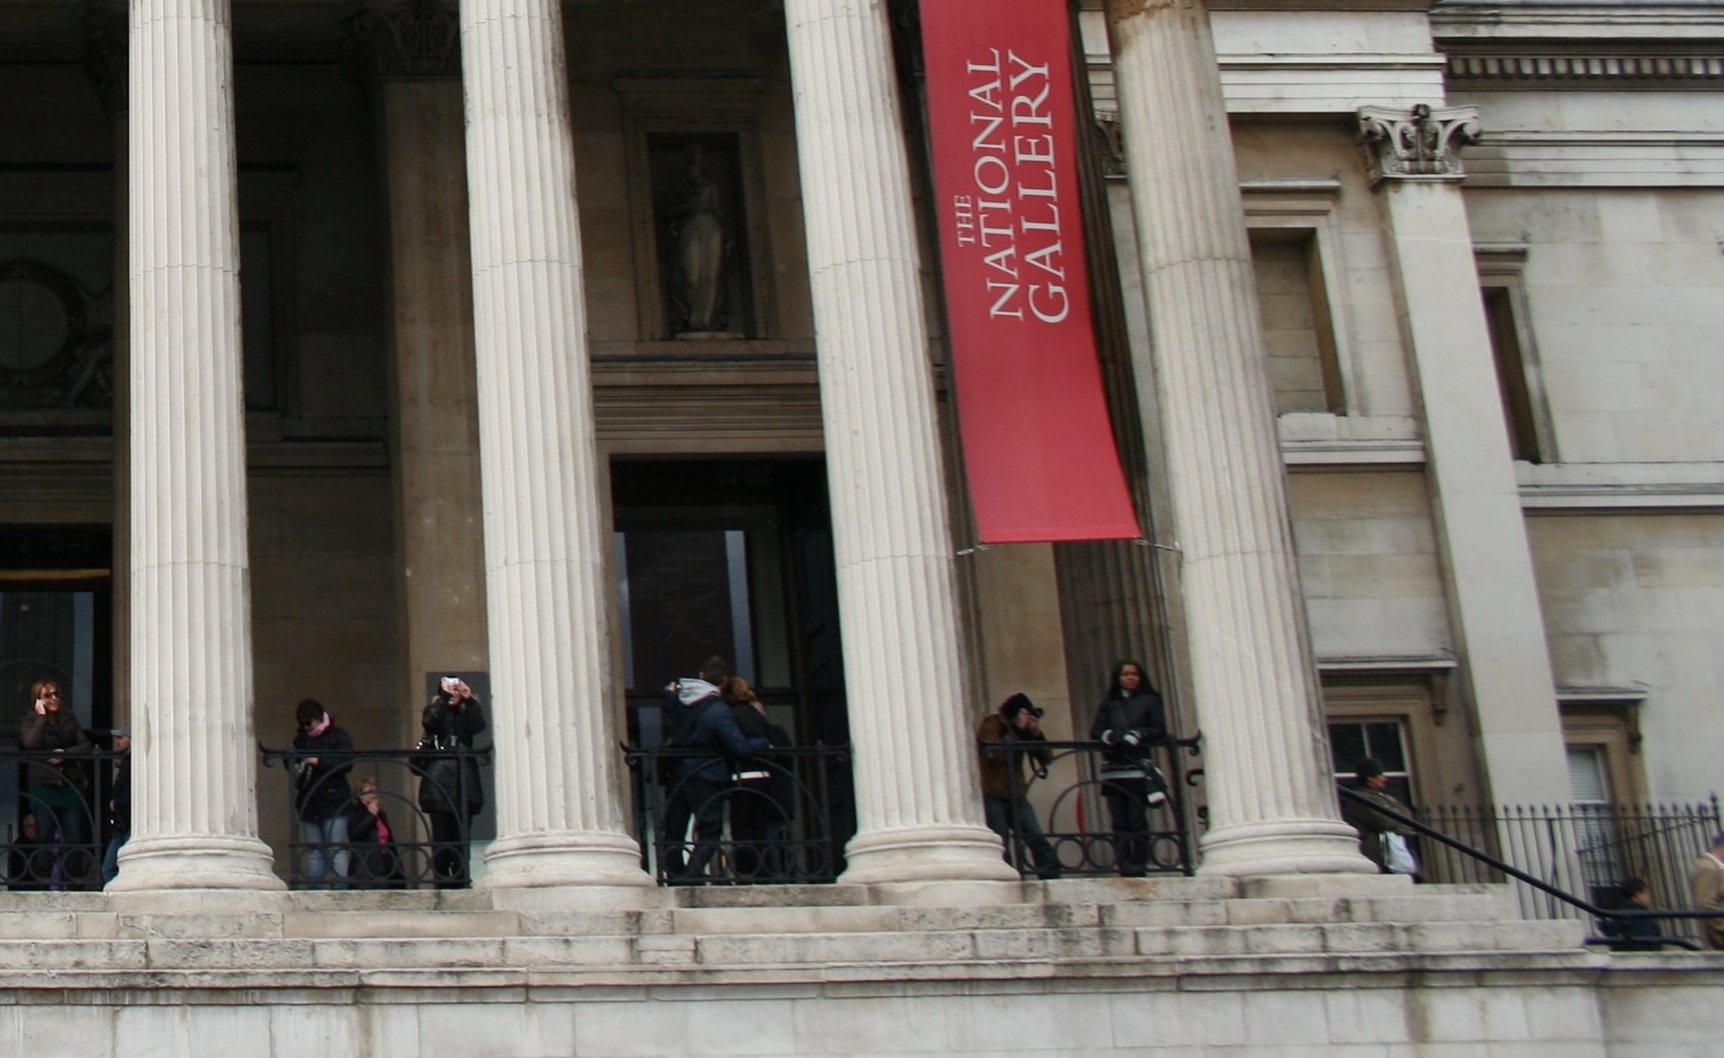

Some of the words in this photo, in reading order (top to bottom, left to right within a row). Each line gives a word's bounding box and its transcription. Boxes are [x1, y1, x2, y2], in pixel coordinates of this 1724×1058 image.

[954, 194, 975, 247] THE
[967, 47, 1023, 321] NATIONAL
[1008, 49, 1069, 324] GALLERY
